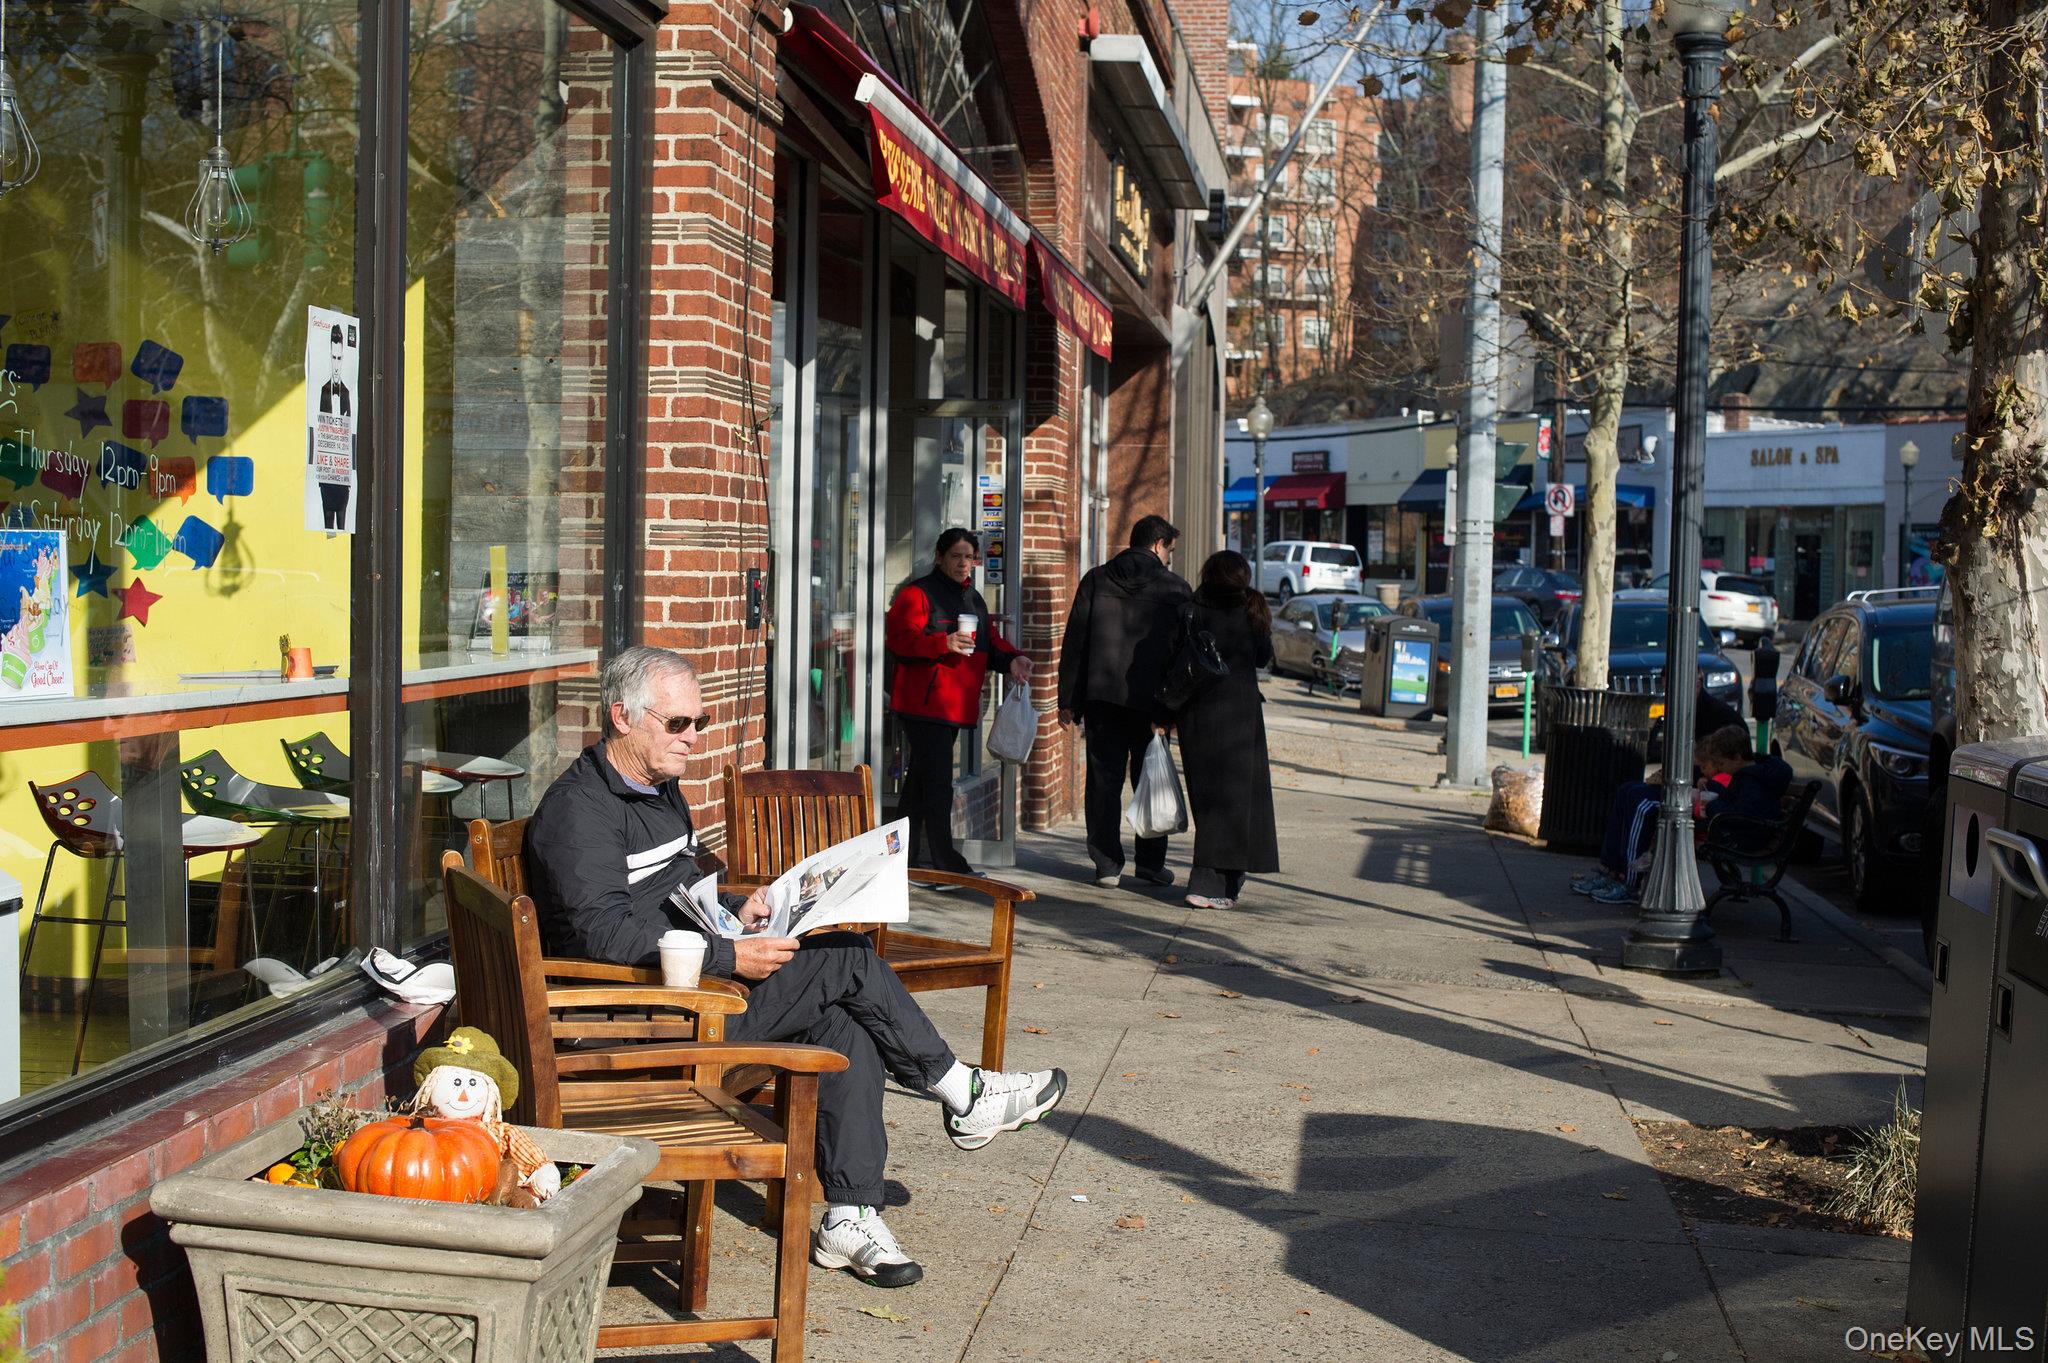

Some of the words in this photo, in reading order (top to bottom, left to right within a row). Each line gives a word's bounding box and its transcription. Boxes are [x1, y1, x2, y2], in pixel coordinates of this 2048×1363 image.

[317, 455, 328, 466] LIKE
[334, 456, 349, 469] SHARE
[1751, 447, 1792, 467] SALON
[1815, 445, 1839, 465] SPA
[31, 499, 102, 574] Saturday
